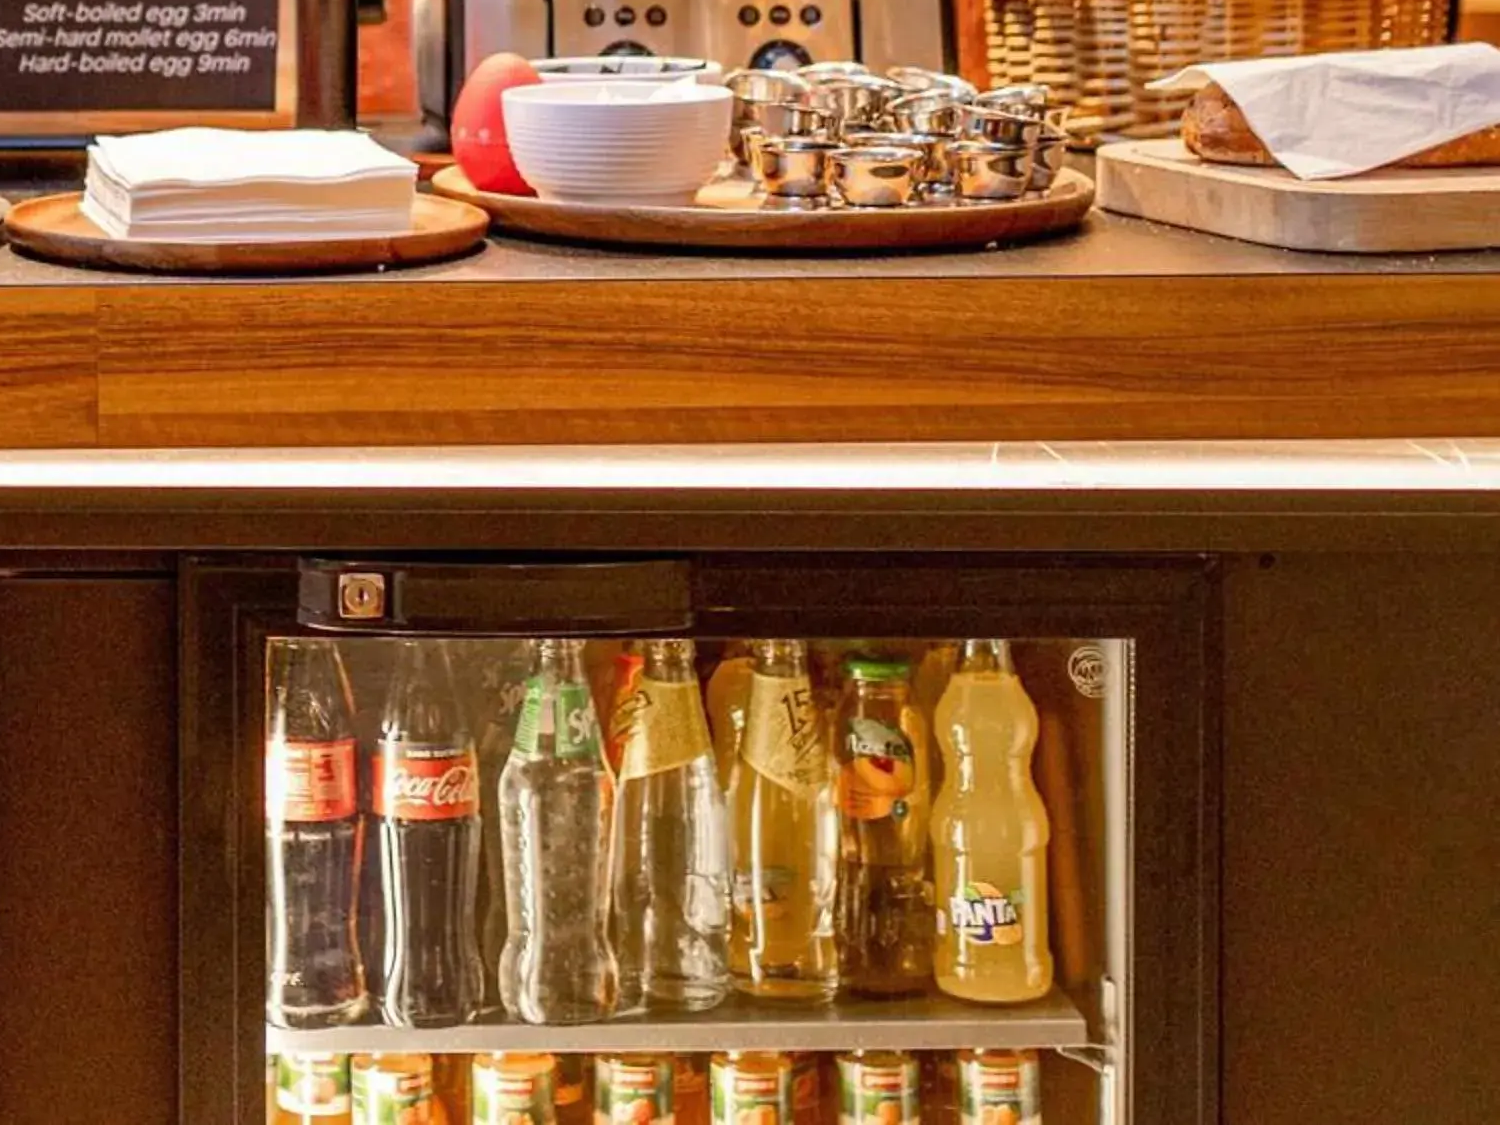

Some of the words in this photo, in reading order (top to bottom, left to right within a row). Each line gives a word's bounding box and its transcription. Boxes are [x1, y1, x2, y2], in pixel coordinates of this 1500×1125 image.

[23, 2, 143, 24] Soft-boiled
[145, 5, 190, 26] egg
[192, 1, 247, 24] 3min
[104, 27, 172, 49] mollet
[175, 31, 220, 53] egg
[223, 27, 277, 49] 6min
[18, 52, 147, 74] Hard-boiled
[149, 56, 193, 78] egg
[195, 52, 251, 74] 9min
